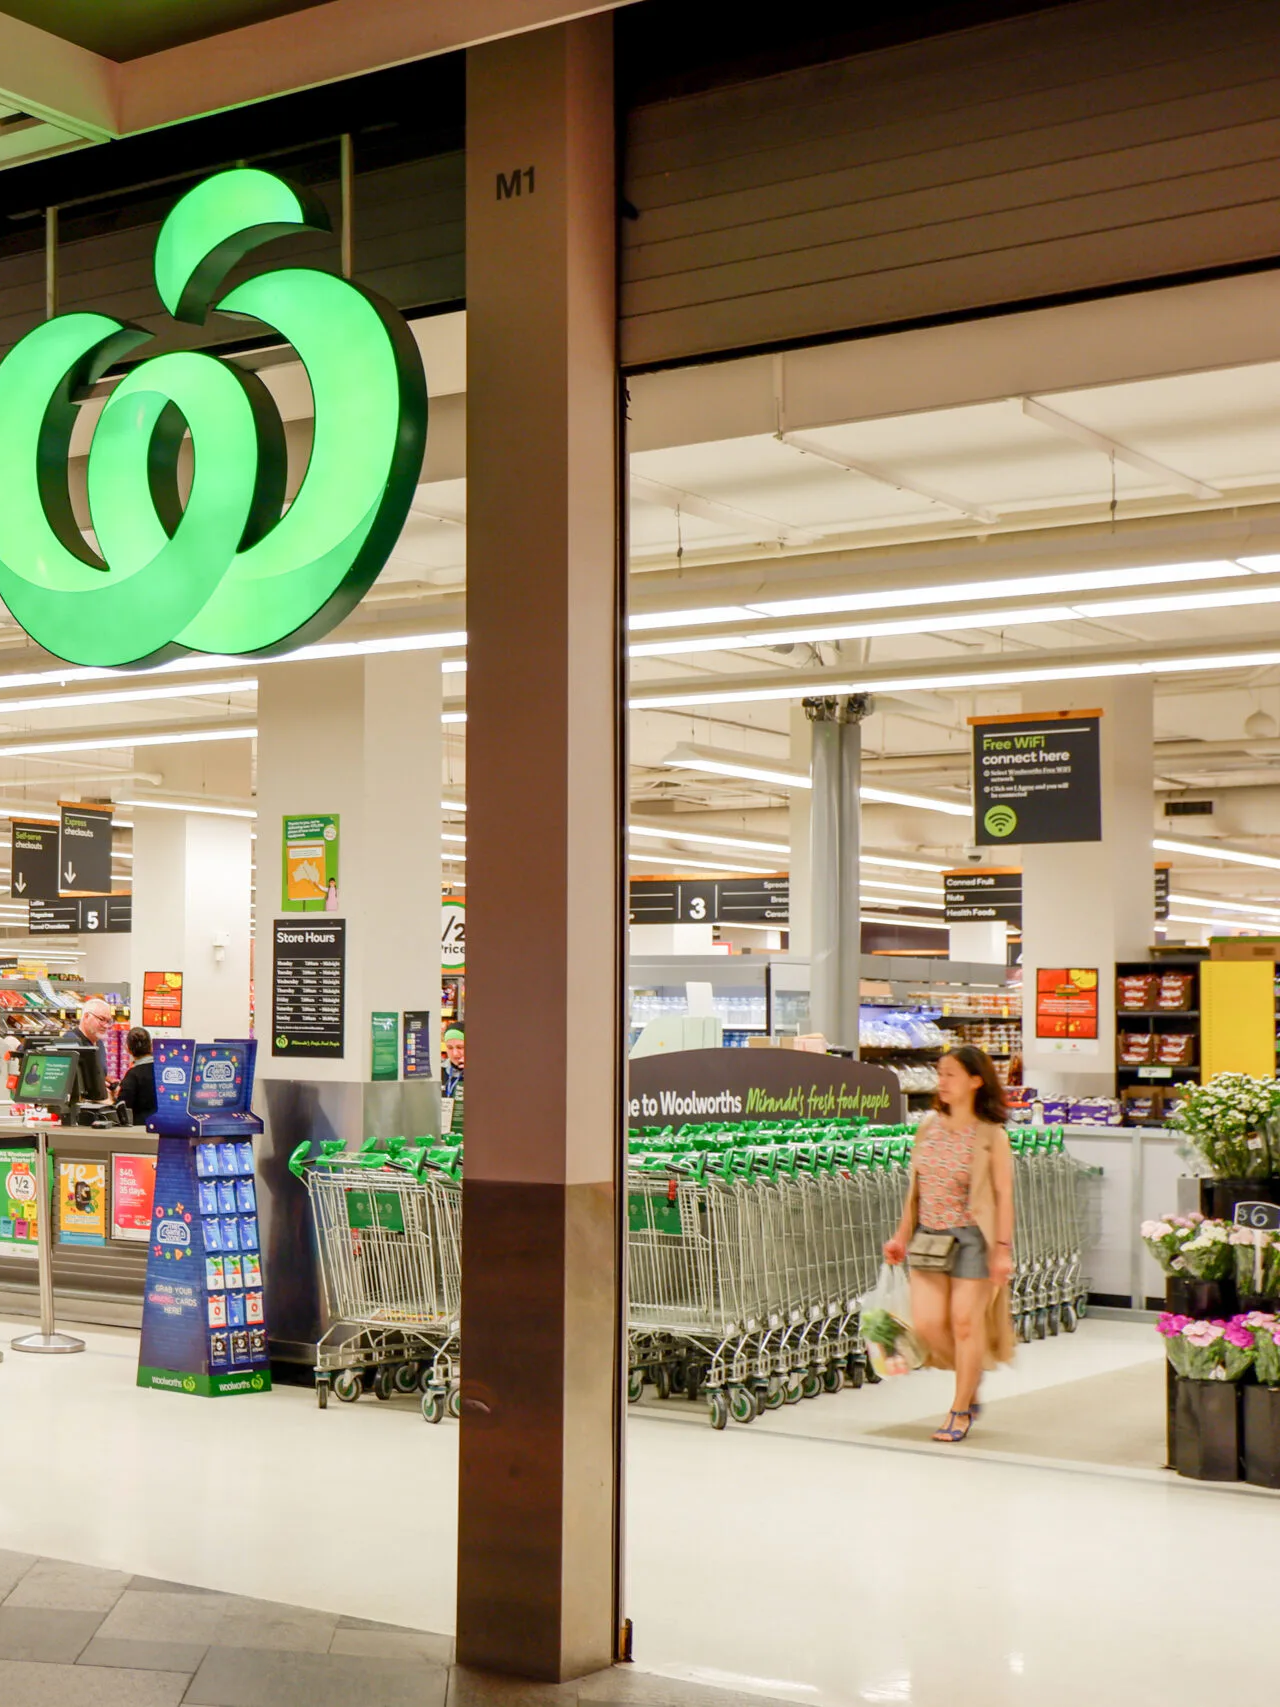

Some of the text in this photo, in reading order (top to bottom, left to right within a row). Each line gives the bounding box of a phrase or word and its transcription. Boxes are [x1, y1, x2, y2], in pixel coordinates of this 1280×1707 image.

[496, 166, 534, 200] M1
[983, 735, 1045, 751] Free WiFi
[982, 749, 1070, 765] connect here
[64, 816, 87, 828] Express
[64, 827, 94, 838] checkouts
[15, 841, 43, 850] checkouts
[946, 877, 995, 886] Canned Fruit
[689, 897, 706, 920] 3
[946, 908, 996, 917] Health Foods
[87, 911, 99, 930] 5
[276, 931, 335, 944] Store Hours
[642, 1094, 657, 1116] to
[659, 1090, 742, 1116] Woolworths
[807, 1084, 835, 1119] fresh
[837, 1083, 860, 1119] food
[860, 1086, 890, 1119] people
[14, 1176, 29, 1189] 1/2
[1238, 1205, 1268, 1227] $6
[155, 1284, 192, 1296] GRAB YOUR
[175, 1297, 197, 1307] CARDS
[151, 1376, 182, 1388] woolworths
[219, 1380, 251, 1391] woolworths
